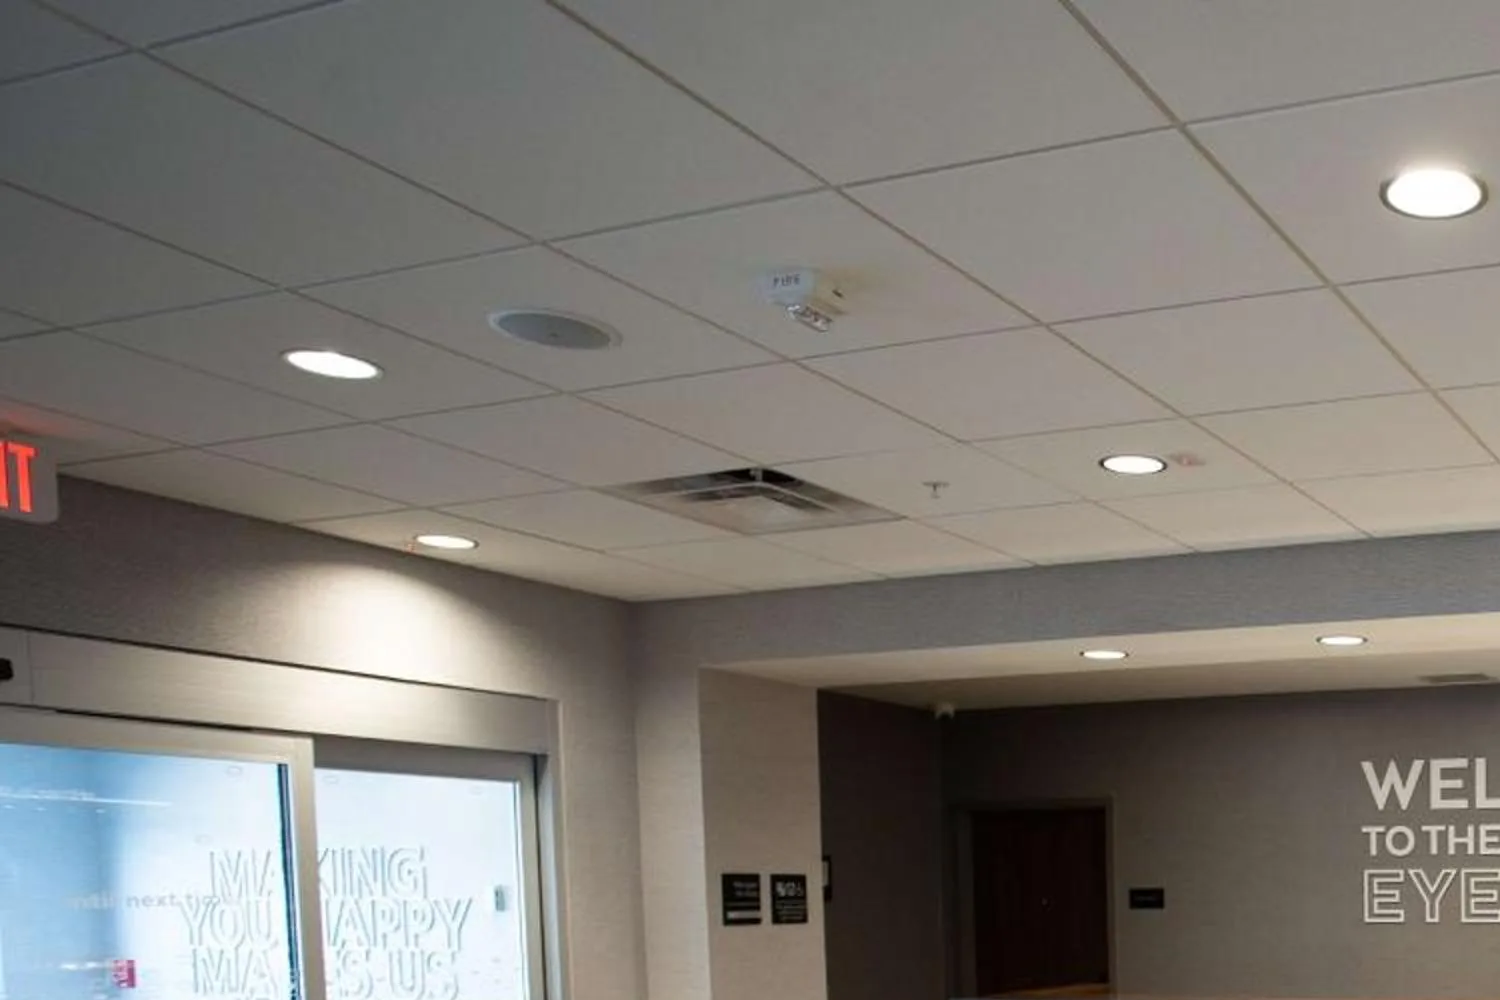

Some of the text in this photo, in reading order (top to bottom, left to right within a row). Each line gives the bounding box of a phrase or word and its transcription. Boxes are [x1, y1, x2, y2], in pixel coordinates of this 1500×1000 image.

[1360, 825, 1416, 857] TO
[178, 897, 279, 949] YOU
[192, 948, 373, 999] MAS
